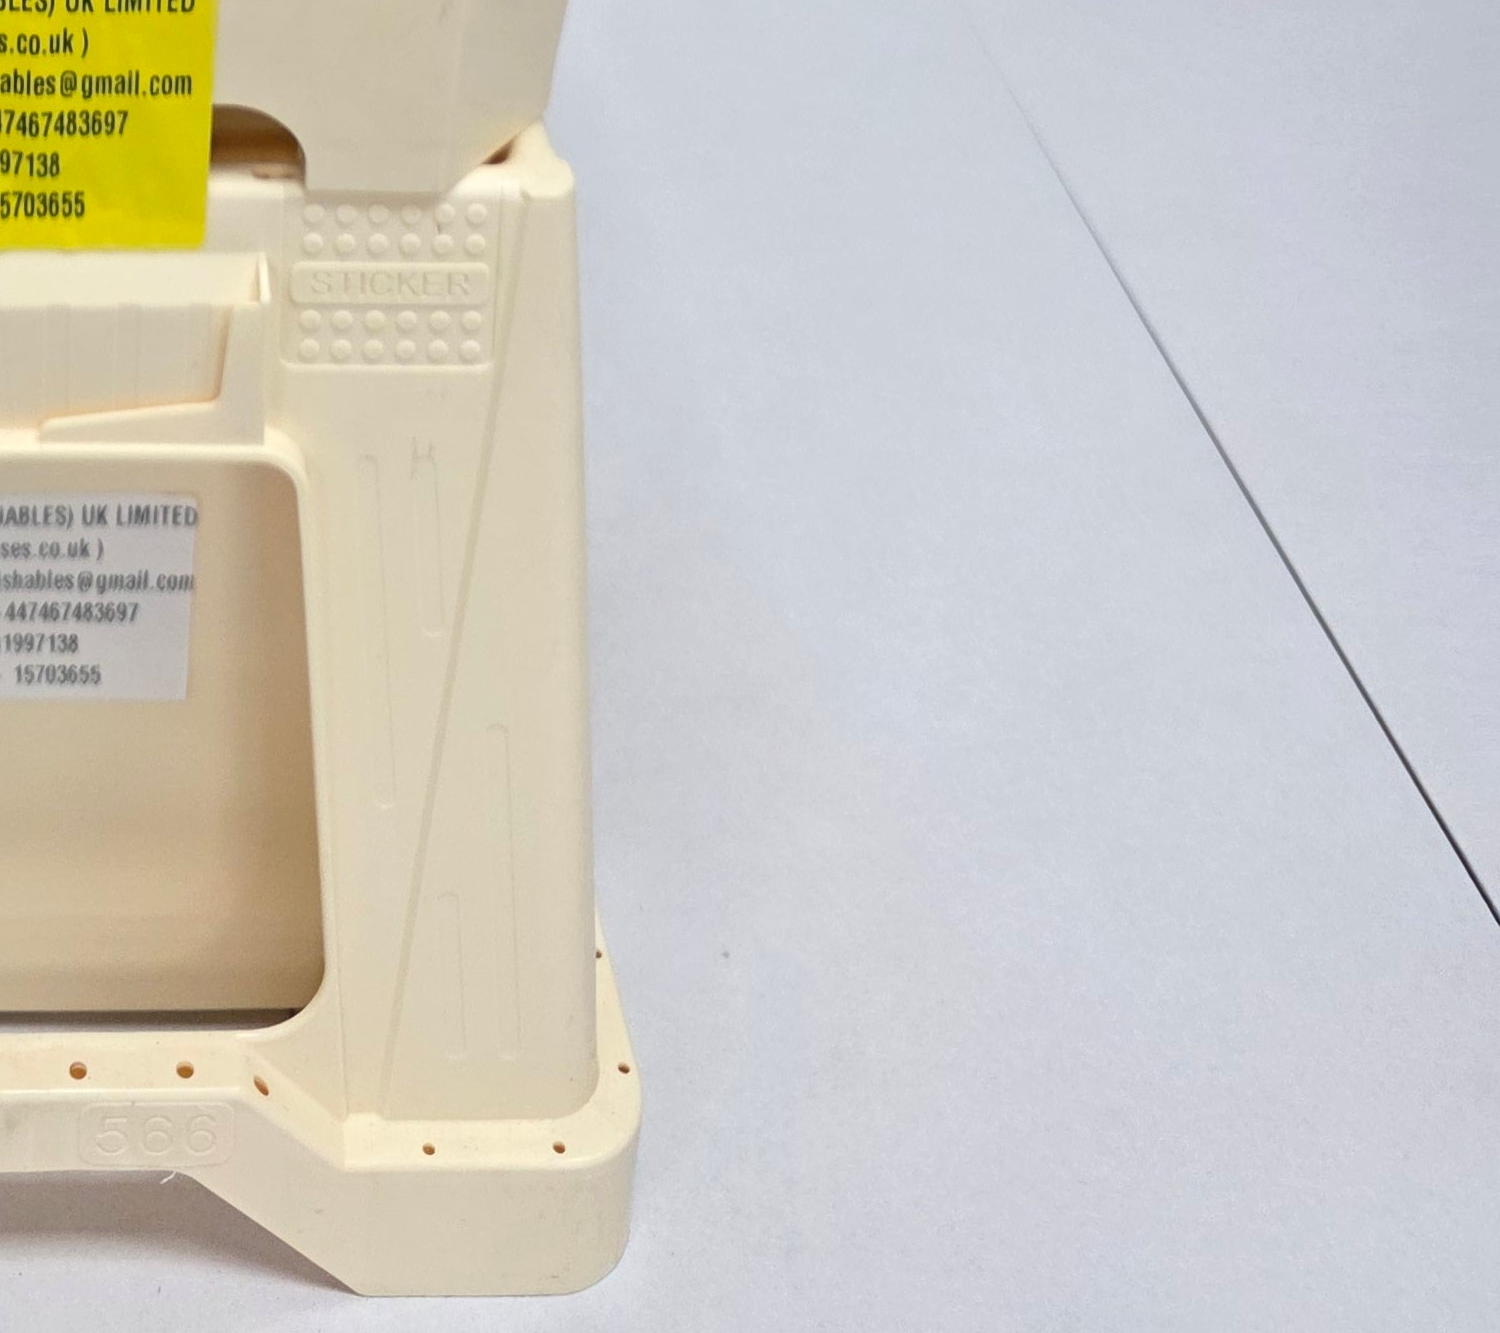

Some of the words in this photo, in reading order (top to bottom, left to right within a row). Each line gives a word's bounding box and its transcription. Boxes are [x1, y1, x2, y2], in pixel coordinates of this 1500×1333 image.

[82, 28, 88, 58] )
[310, 270, 471, 296] STICKER
[82, 505, 107, 526] UK
[117, 505, 198, 526] LIMITED
[15, 664, 101, 685] 15703655
[94, 1115, 218, 1157] 566
